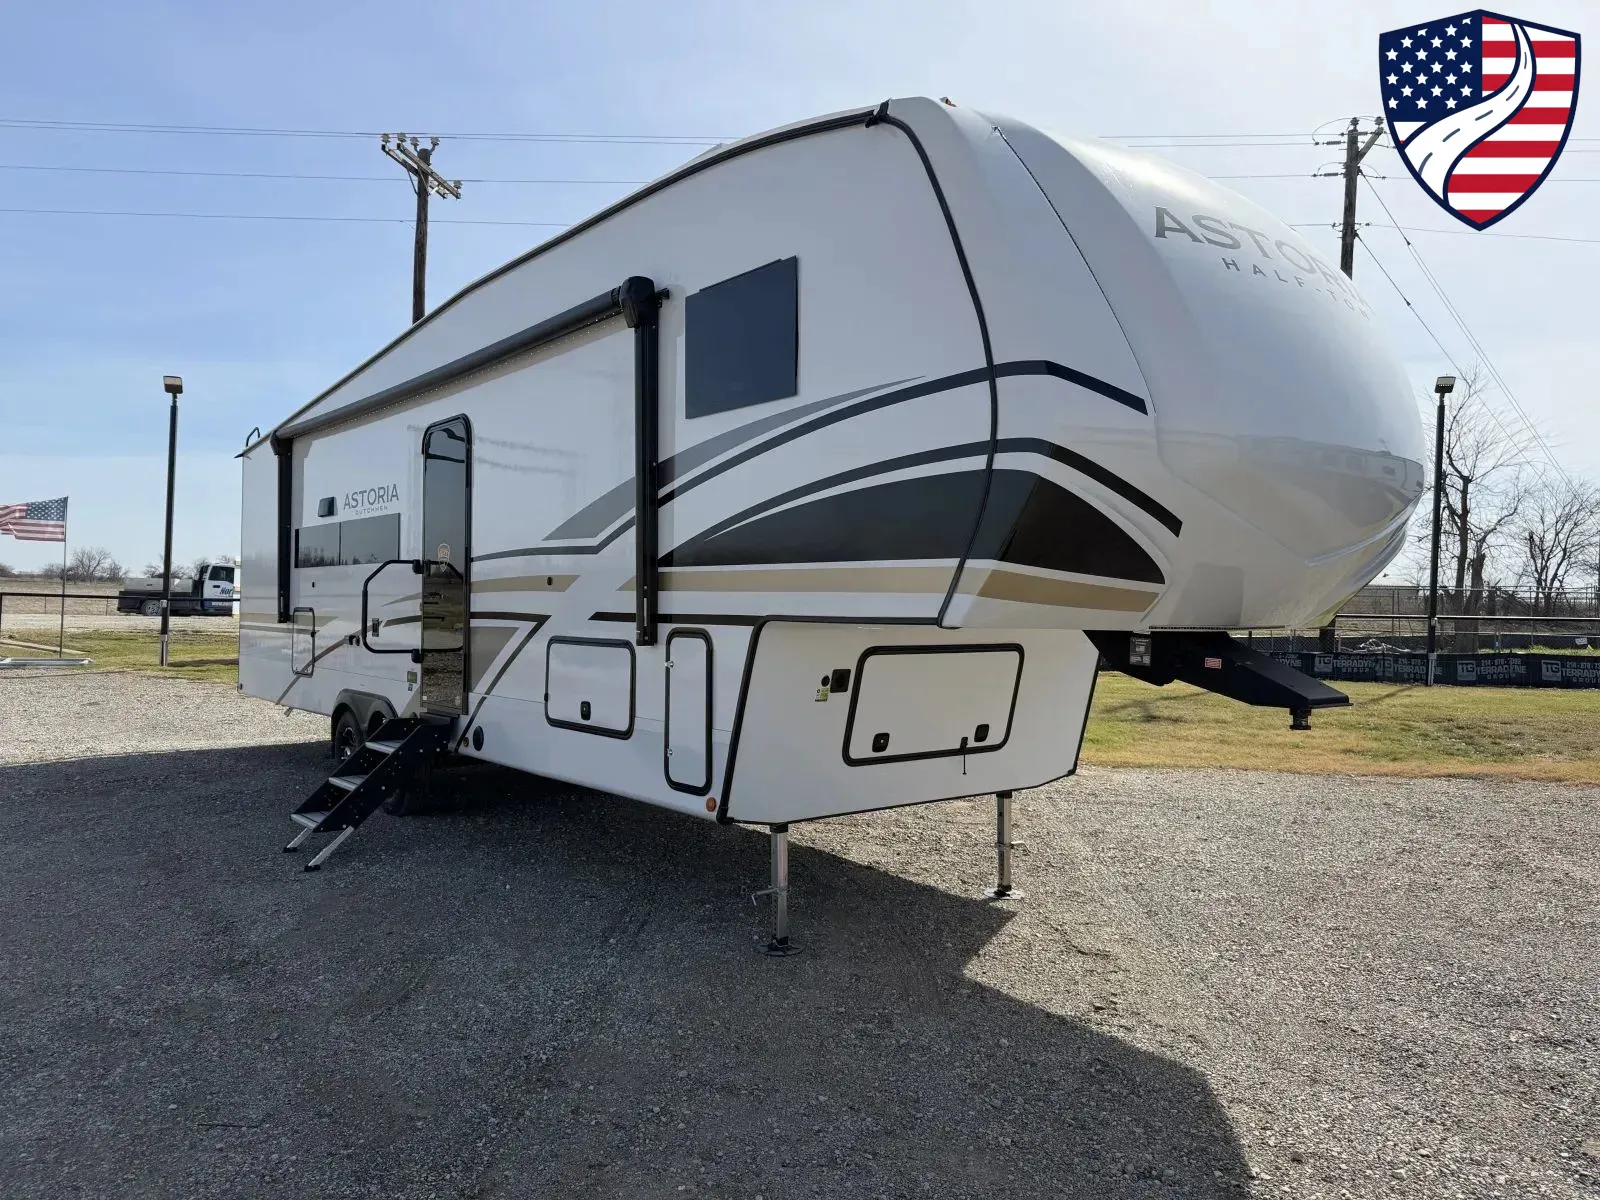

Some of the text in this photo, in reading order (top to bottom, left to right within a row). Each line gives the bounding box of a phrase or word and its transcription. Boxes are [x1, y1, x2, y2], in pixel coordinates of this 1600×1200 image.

[1153, 205, 1377, 317] ASTORIA
[343, 483, 400, 510] ASTORIA
[355, 505, 388, 516] DUTCHMEN
[1476, 664, 1527, 676] TERRADYNE
[1561, 667, 1600, 678] TERRADY
